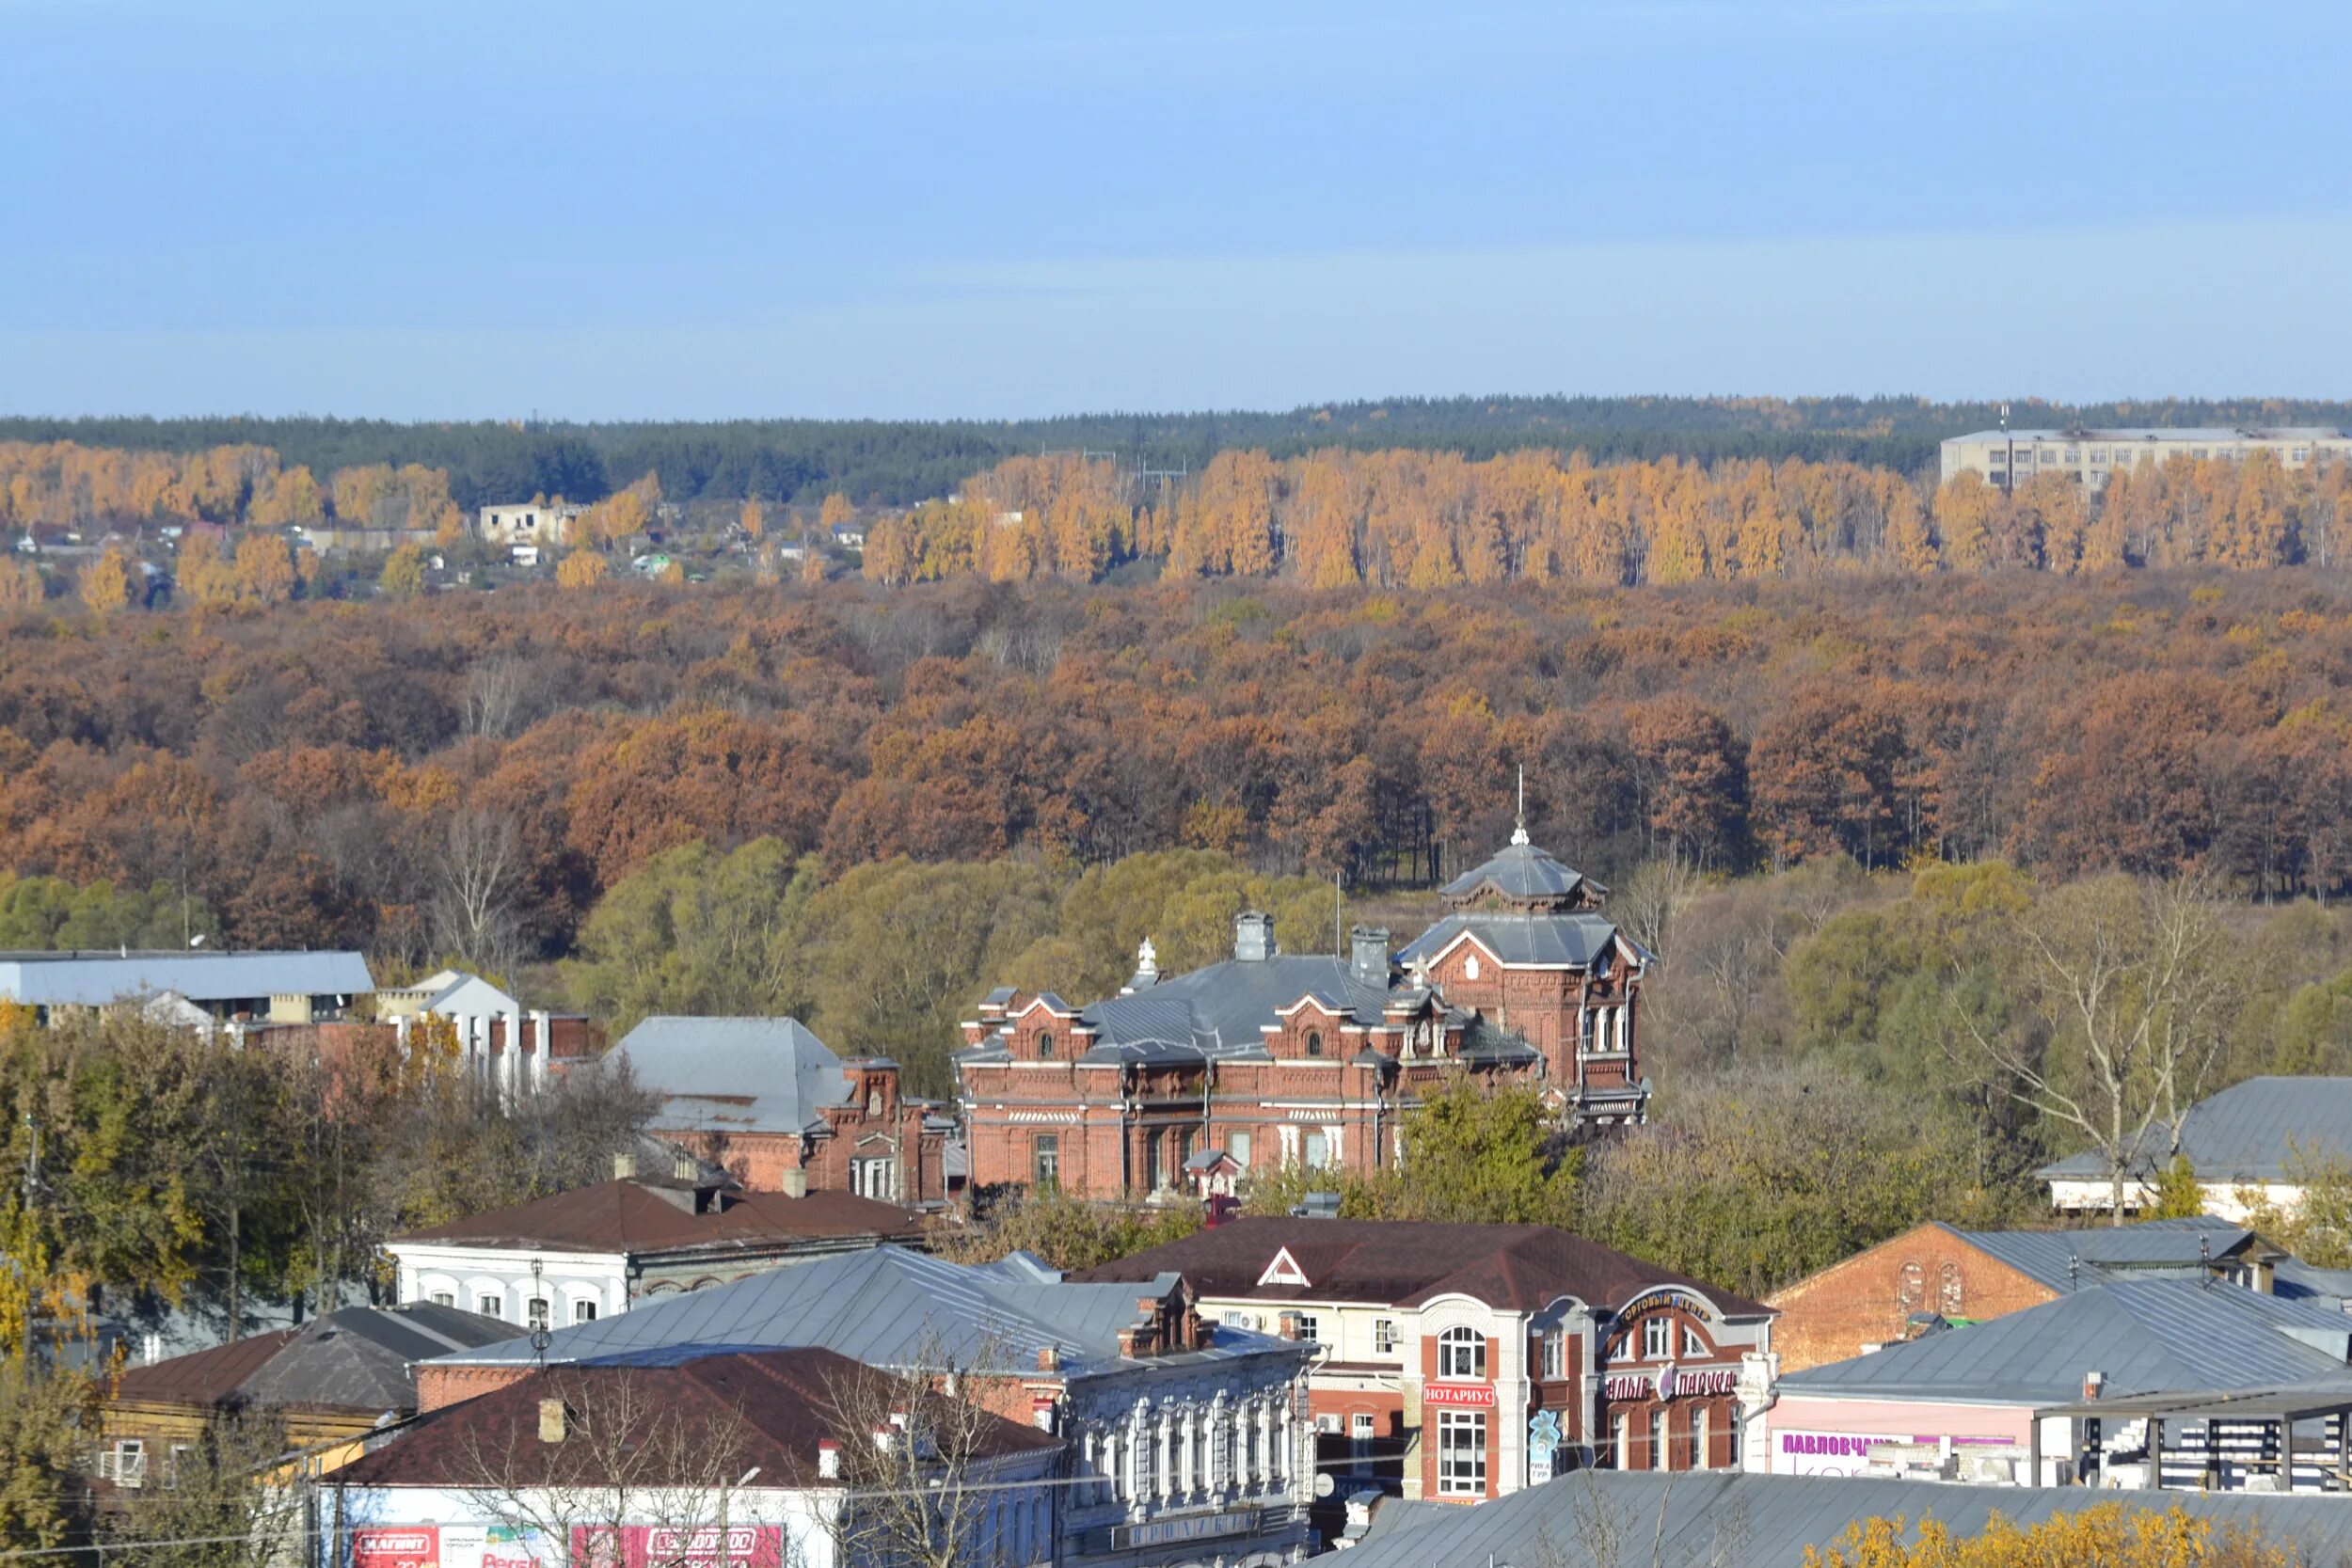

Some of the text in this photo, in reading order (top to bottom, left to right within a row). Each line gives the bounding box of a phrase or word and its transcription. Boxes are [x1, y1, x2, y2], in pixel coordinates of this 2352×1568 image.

[1425, 1388, 1493, 1402] НОТАРИУС
[1605, 1370, 1734, 1400] АЛЫЕ ПАРУСА
